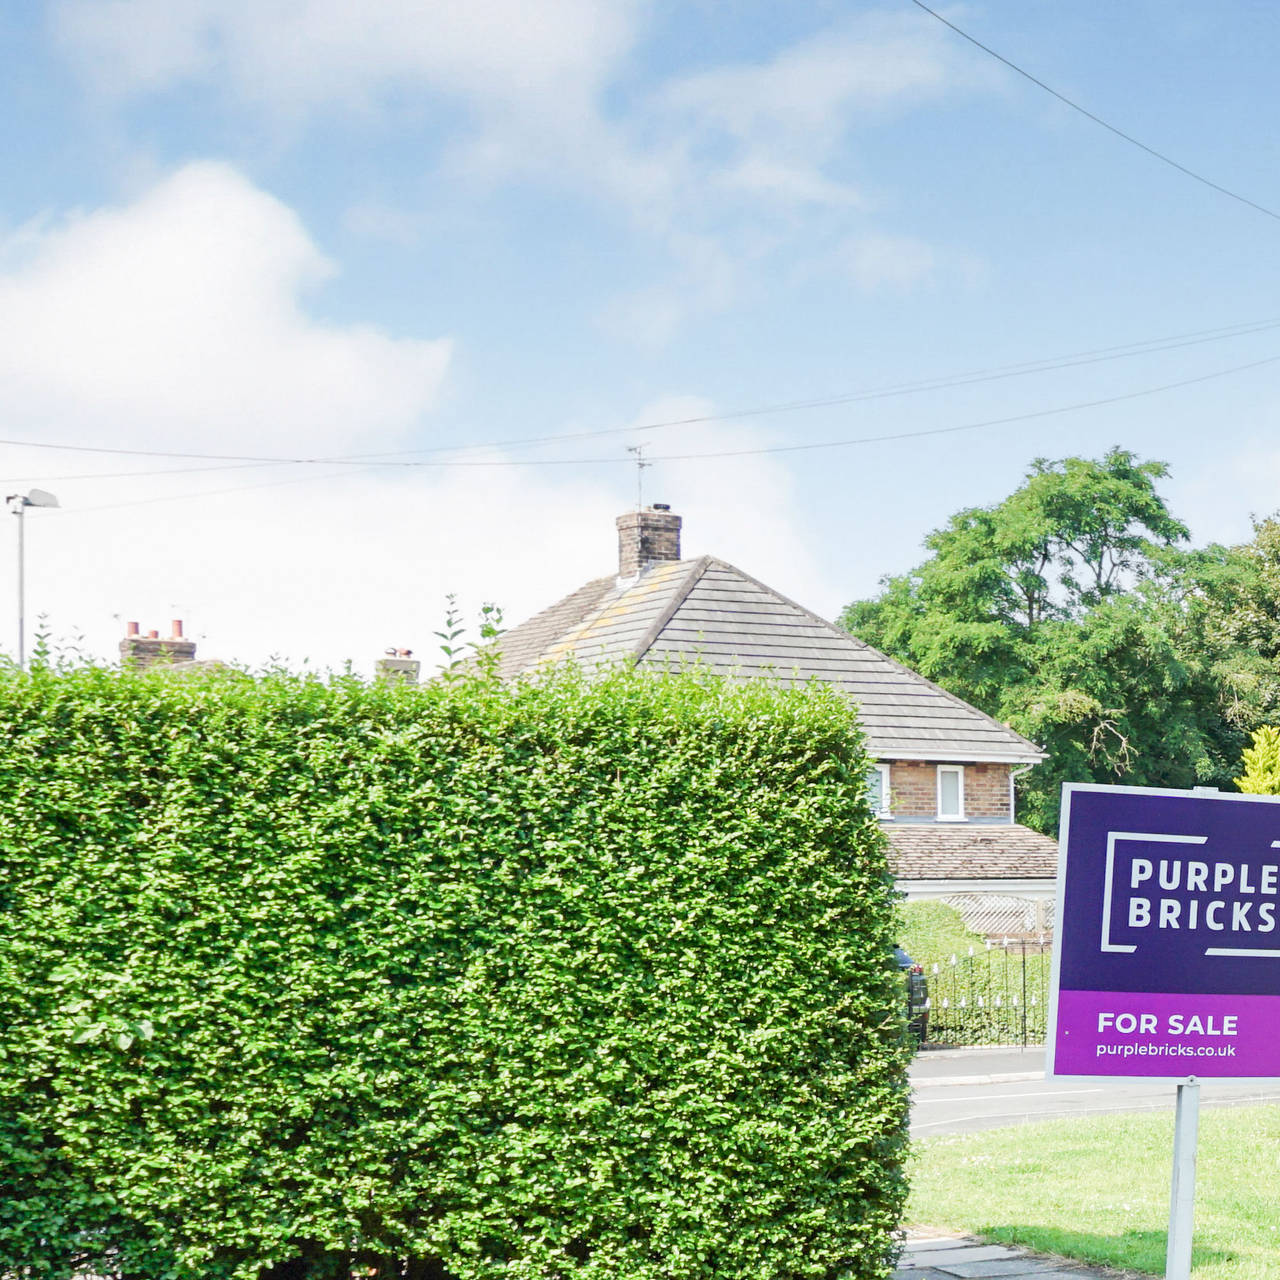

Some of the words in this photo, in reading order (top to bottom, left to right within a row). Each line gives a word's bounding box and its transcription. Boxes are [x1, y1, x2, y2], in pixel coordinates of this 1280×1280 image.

[1130, 858, 1279, 895] PURPLE
[1128, 897, 1276, 933] BRICKS
[1097, 1012, 1157, 1035] FOR
[1167, 1014, 1238, 1036] SALE
[1096, 1042, 1236, 1057] purplebricks.co.uk
